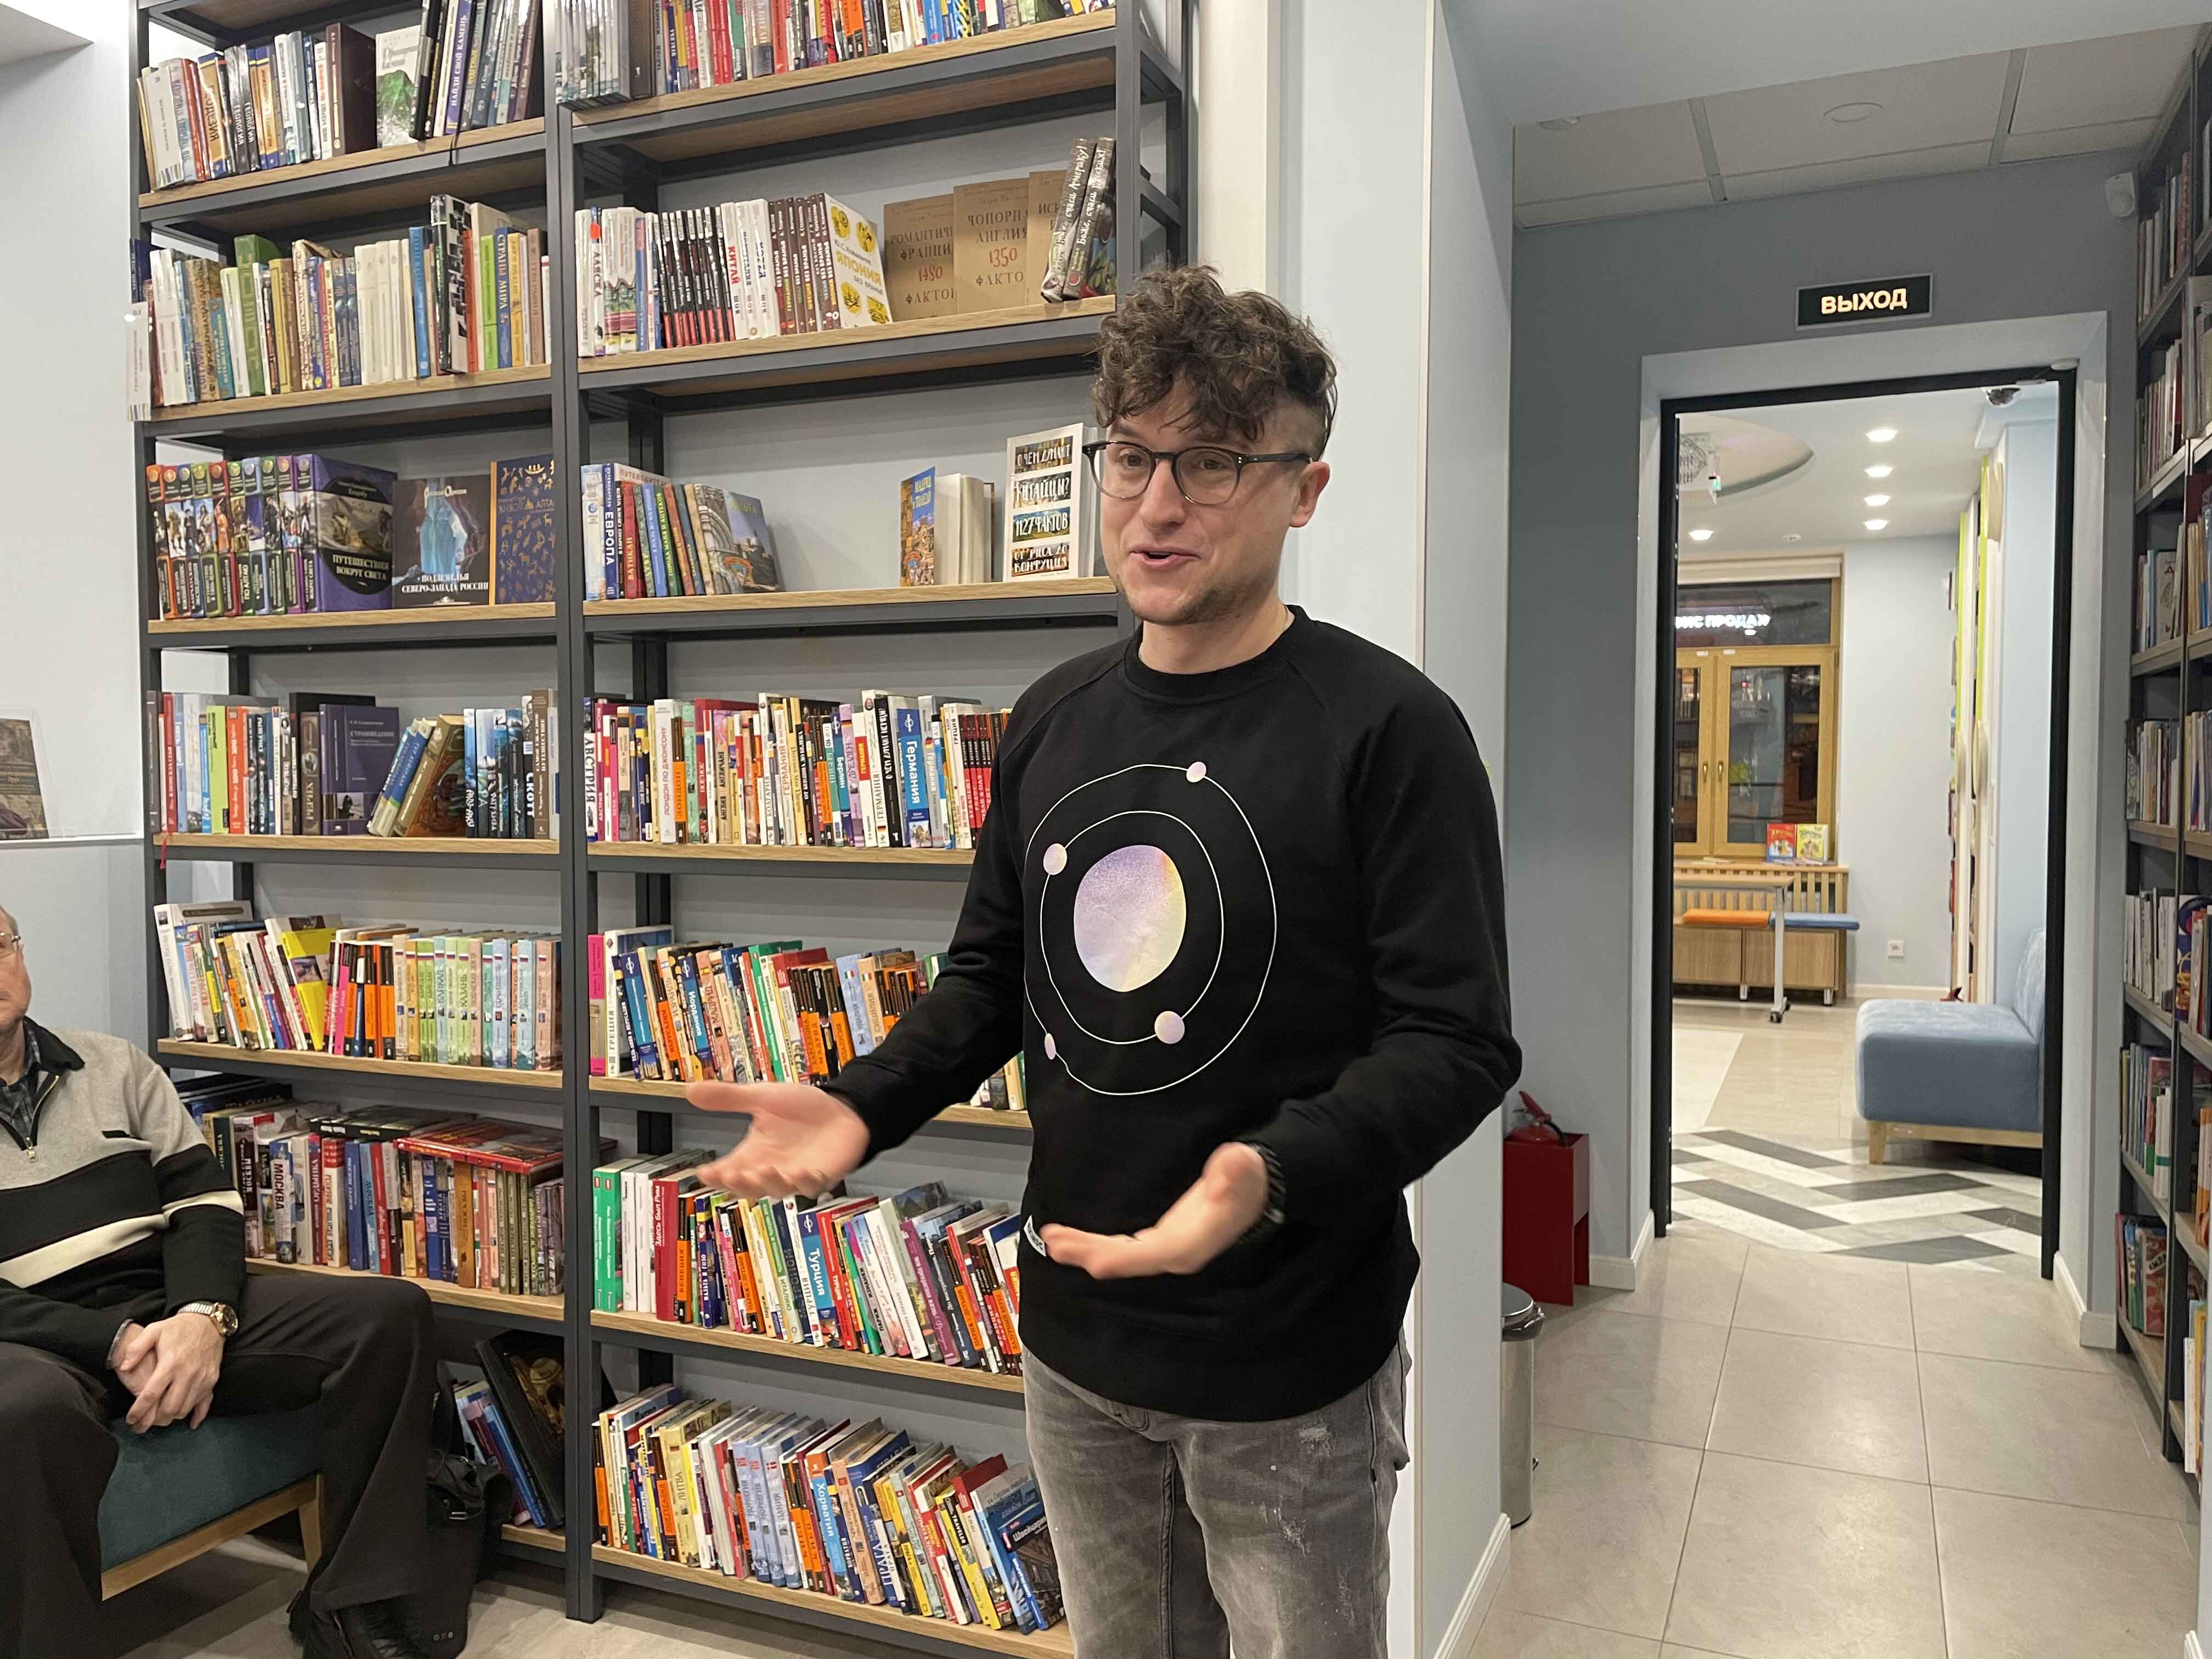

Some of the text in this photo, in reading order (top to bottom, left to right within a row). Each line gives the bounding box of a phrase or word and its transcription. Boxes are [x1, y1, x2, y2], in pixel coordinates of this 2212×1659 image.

[451, 14, 467, 106] НАЙДИ СВОЙ КАМЕНЬ
[233, 105, 246, 145] ГЕОЛОГИЯ
[245, 102, 256, 143] ГЕОЛОГИЯ
[1069, 145, 1088, 190] Америку!
[1065, 192, 1076, 217] спаси
[1076, 191, 1097, 245] Боже, спаси
[497, 235, 507, 309] СТРАНЫ МИРА
[592, 252, 602, 297] АЛЯСКА
[728, 246, 738, 284] КИТАЙ
[835, 251, 882, 285] ЯПОНИЯ
[918, 266, 943, 281] 1480
[989, 247, 1017, 268] 1350
[1821, 288, 1908, 314] ВЫХОД
[1018, 455, 1023, 466] О
[1041, 443, 1071, 462] ДУМАЮТ
[1015, 477, 1070, 502] КИТАЙЦЫ?
[605, 511, 615, 565] ЕВРОПА
[1015, 512, 1068, 537] 1127 ФАКТОВ
[332, 554, 388, 569] ПУТЕШЕСТВИЯ
[1014, 557, 1068, 573] КОНФУЦИЯ
[1030, 548, 1052, 558] РИСА
[1056, 545, 1068, 554] ДО
[336, 566, 387, 581] ВОКРУГ СВЕТА
[402, 582, 488, 593] СЕВЕРО-ЗАПАДА РОССИИ
[421, 573, 469, 583] ПОДЗЕМЕЛЬЯ
[584, 738, 595, 803] АВСТРИЯ
[661, 727, 670, 816] ЛОНДОН ПО ДЖОНСОНУ
[718, 752, 726, 788] АНГЛИЧАНЕ
[779, 746, 790, 796] ГЕРМАНИЯ
[837, 756, 846, 788] Берлин
[845, 742, 856, 780] ДРЕЗДЕН
[906, 740, 920, 803] Германия
[927, 751, 936, 791] Германия
[466, 789, 475, 828] АКУ-АКУ
[477, 790, 488, 808] РА
[872, 773, 884, 819] ГЕРМАНИЯ
[965, 778, 974, 819] БУДАПЕШТ
[665, 977, 679, 1017] ИЗРАИЛЬ
[688, 991, 702, 1036] Иордания
[706, 985, 719, 1024] МАДРИД
[867, 991, 881, 1032] СИЦИЛИЯ
[662, 1008, 675, 1053] ИЕРУСАЛИМ
[811, 1022, 823, 1065] МАДРИД
[274, 1163, 284, 1210] МОСКВА
[653, 1186, 662, 1200] Рим
[654, 1221, 662, 1246] Здесь
[810, 1248, 825, 1296] Турция
[832, 1274, 842, 1300] ТУРЦИЯ
[779, 1279, 792, 1311] ИТАЛИЮ
[803, 1278, 815, 1317] ТУРЦИЯ
[860, 1267, 884, 1331] ПАРИЖ ИЗНАНКИ
[676, 1471, 687, 1500] ЛИТВА
[742, 1480, 753, 1516] НОРВЕГИЯ
[755, 1482, 766, 1520] НОРВЕГИЯ
[774, 1493, 785, 1520] ДАНИЯ
[816, 1483, 834, 1536] Хорватия
[952, 1514, 967, 1545] TRAVELER
[872, 1543, 893, 1586] ПРАГА
[883, 1544, 895, 1572] ПРАГА
